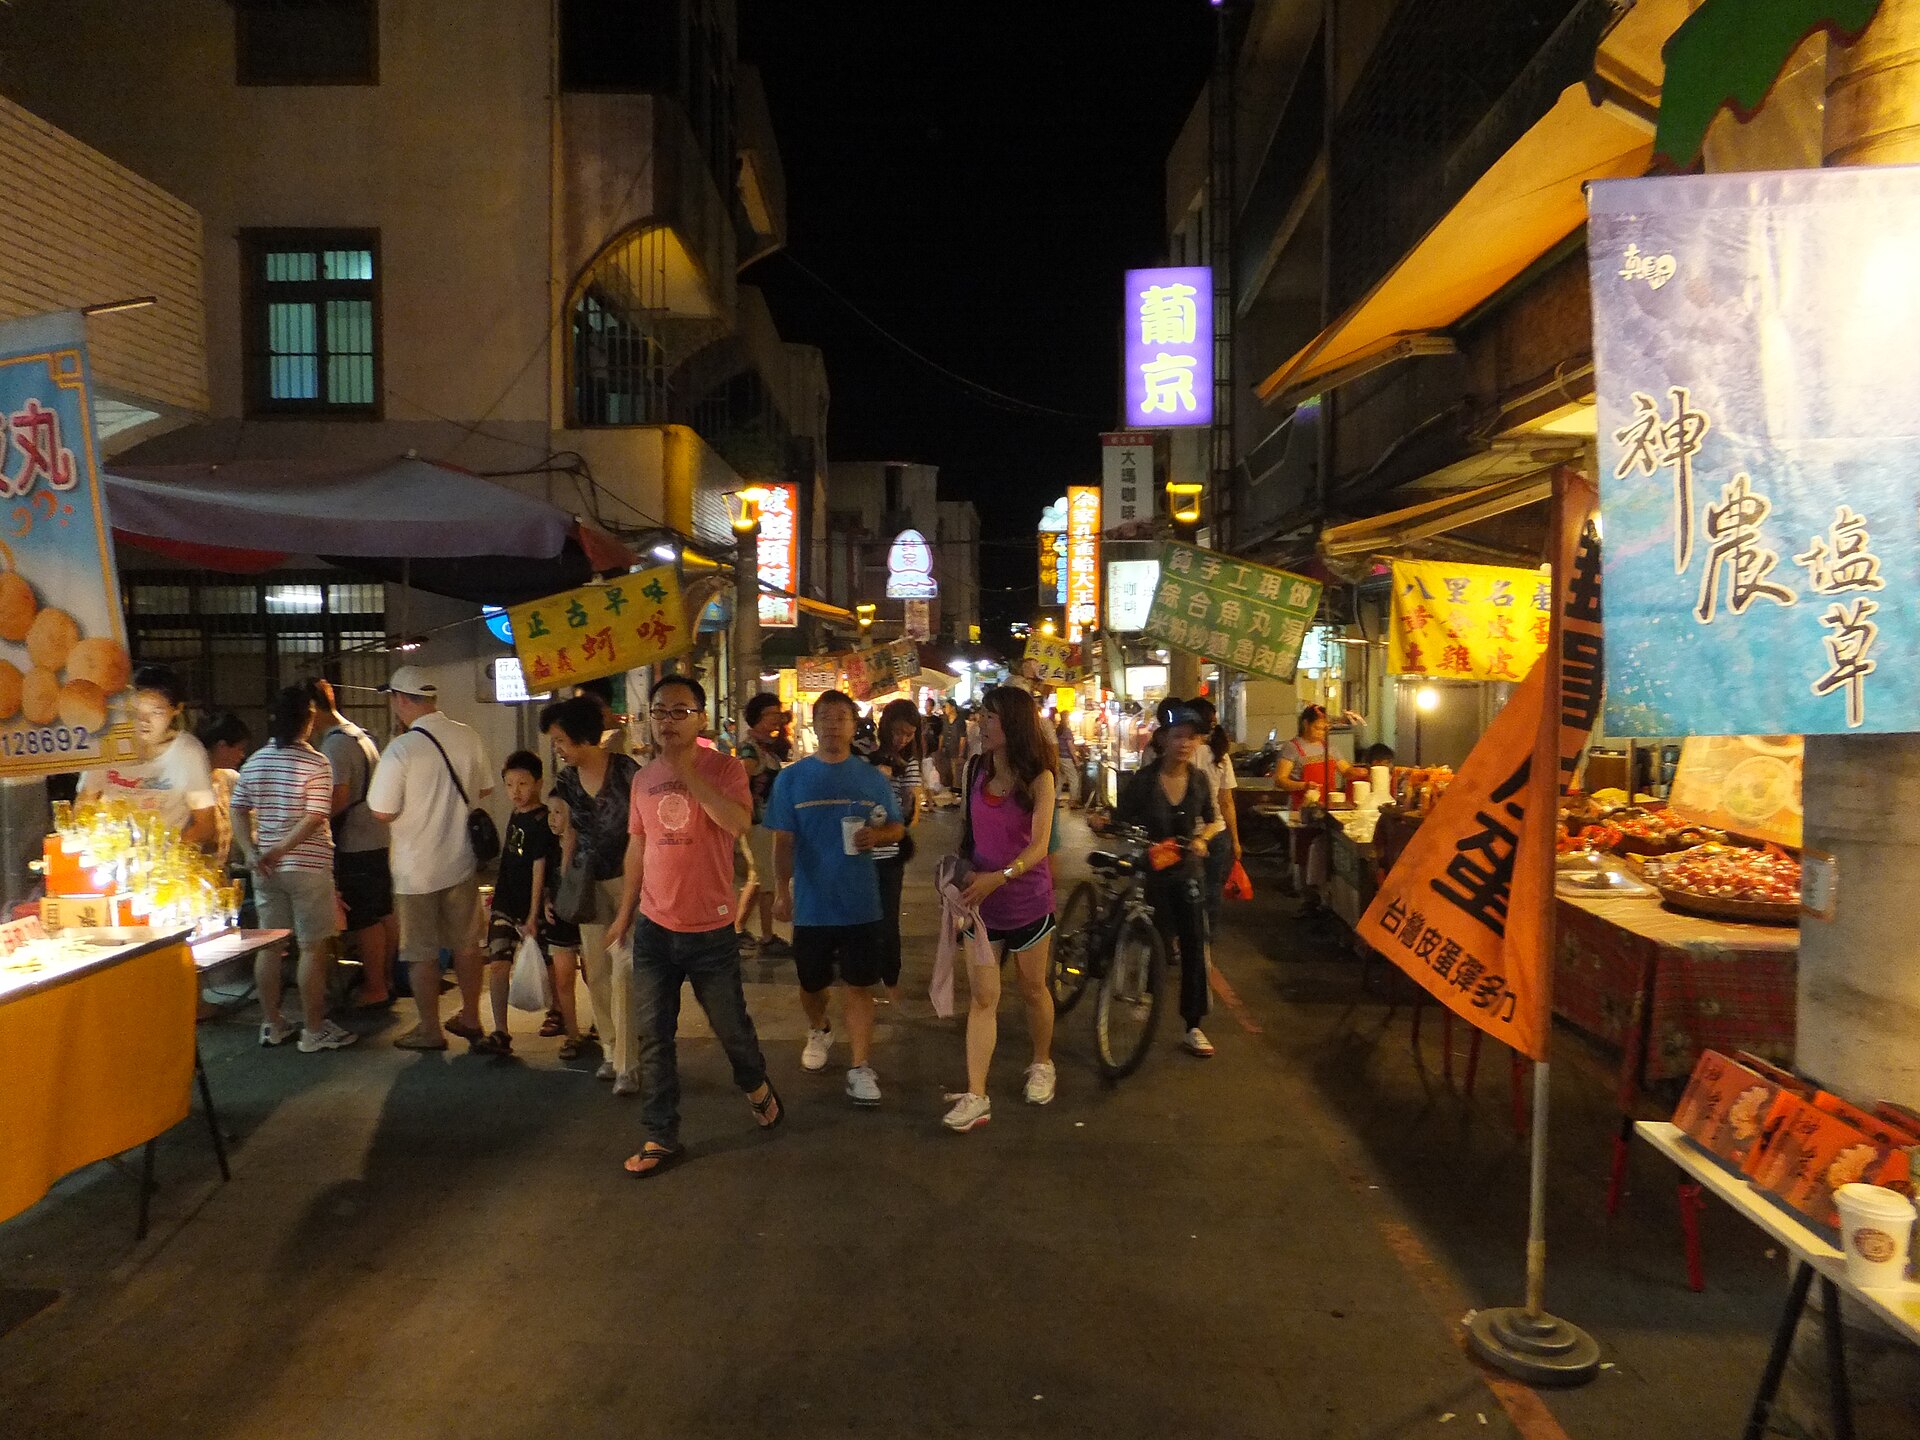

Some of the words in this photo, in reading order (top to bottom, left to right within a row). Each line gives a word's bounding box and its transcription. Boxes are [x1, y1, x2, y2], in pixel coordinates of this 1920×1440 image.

[1140, 283, 1197, 413] 葡京
[0, 398, 77, 498] 丸
[1401, 641, 1544, 679] 土雞皮
[2, 726, 90, 757] 128692
